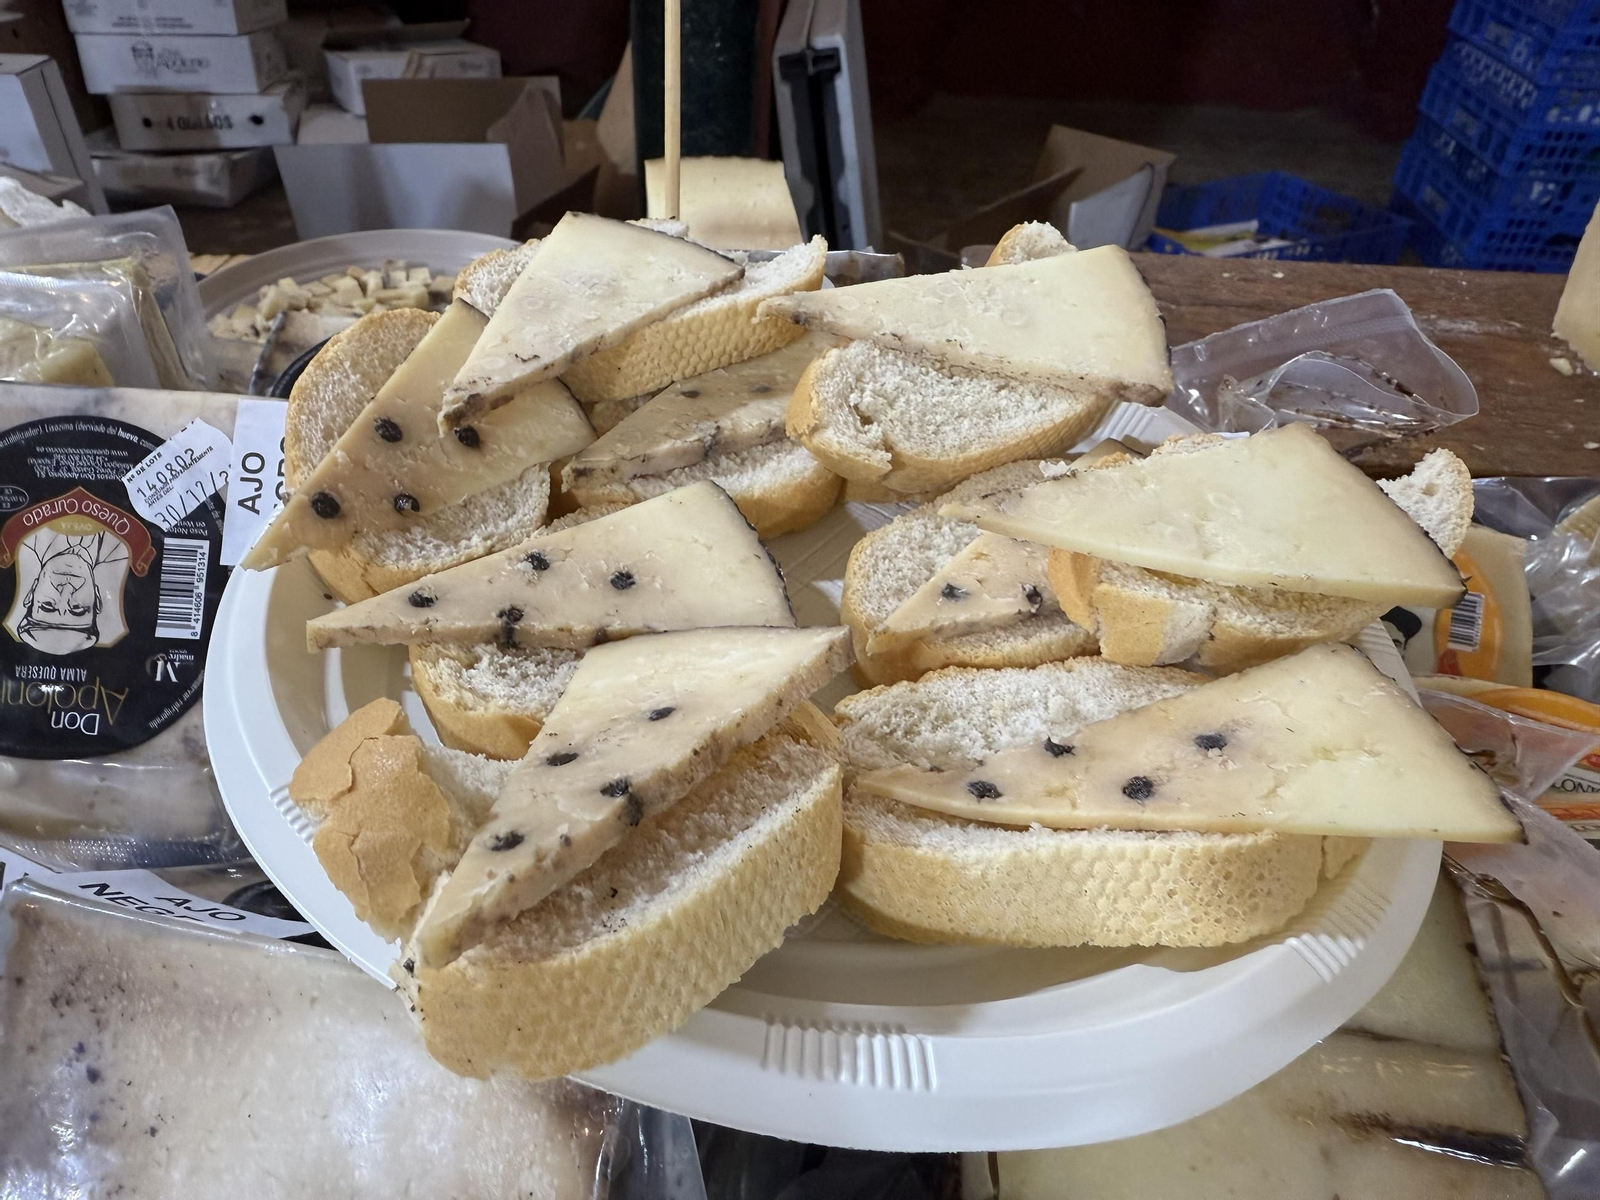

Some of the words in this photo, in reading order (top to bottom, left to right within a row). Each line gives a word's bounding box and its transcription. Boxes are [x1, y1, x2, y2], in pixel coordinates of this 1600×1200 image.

[136, 465, 147, 476] DE
[145, 451, 163, 468] LOTE
[237, 451, 266, 516] AJO
[22, 498, 79, 526] Curado
[81, 500, 131, 535] Queso
[196, 551, 207, 584] 951314
[193, 591, 203, 625] 414606
[15, 664, 57, 680] QUESERA
[60, 664, 88, 683] ALMA
[1, 675, 129, 726] Apoloni
[50, 710, 100, 735] Don
[154, 895, 247, 921] AJO
